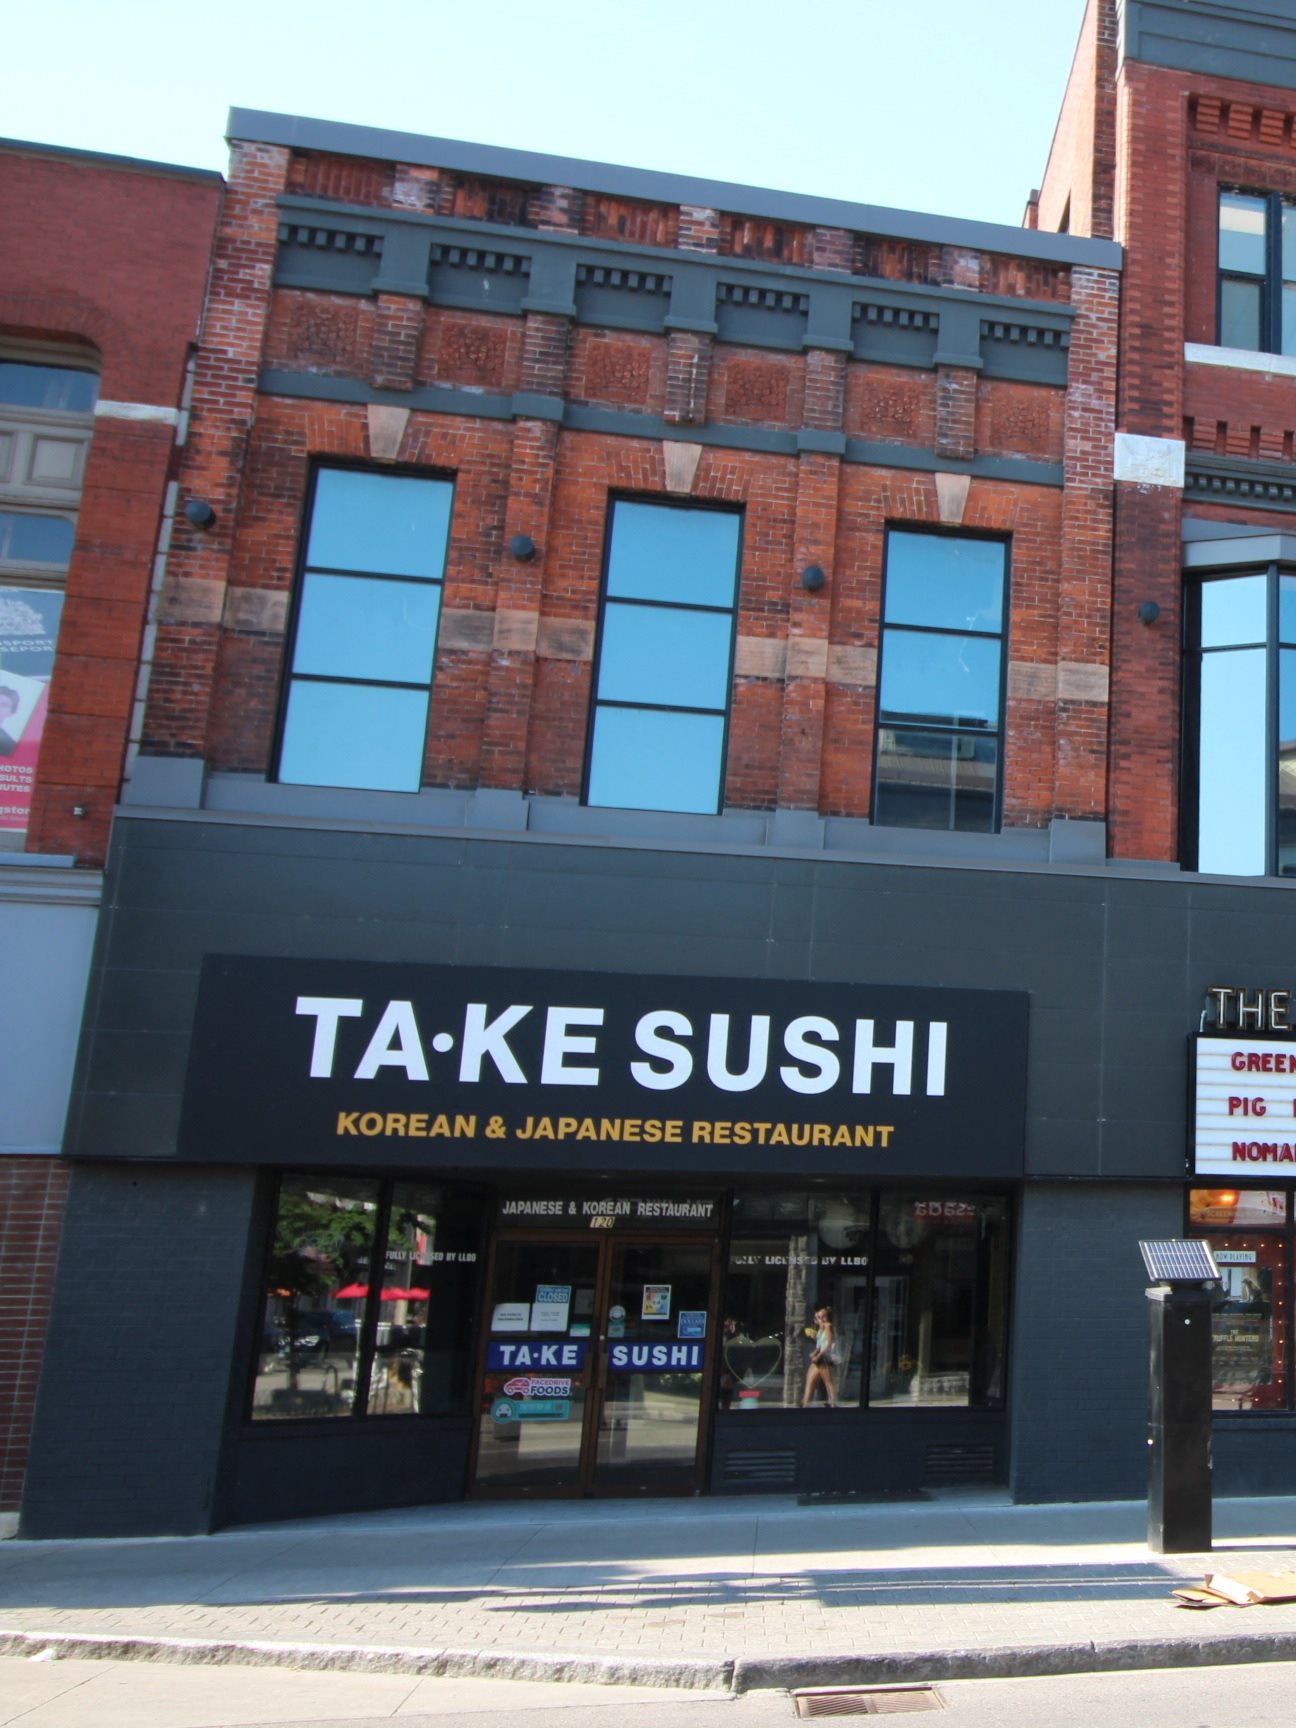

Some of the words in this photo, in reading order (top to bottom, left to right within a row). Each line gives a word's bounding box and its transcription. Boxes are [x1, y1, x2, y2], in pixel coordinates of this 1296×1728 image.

[1208, 985, 1293, 1030] THE
[630, 1010, 948, 1097] SUSHI
[1228, 1096, 1267, 1117] PIG
[336, 1111, 477, 1138] KOREAN
[484, 1115, 507, 1139] &
[515, 1116, 683, 1144] JAPANESE
[691, 1120, 895, 1149] RESTAURANT
[502, 1201, 563, 1215] JAPANESE
[568, 1201, 577, 1215] &
[582, 1201, 631, 1215] KOREAN
[637, 1202, 713, 1217] RESTAURANT
[538, 1293, 568, 1303] CLOSED
[612, 1345, 699, 1366] SUSHI
[530, 1386, 569, 1395] FOODS
